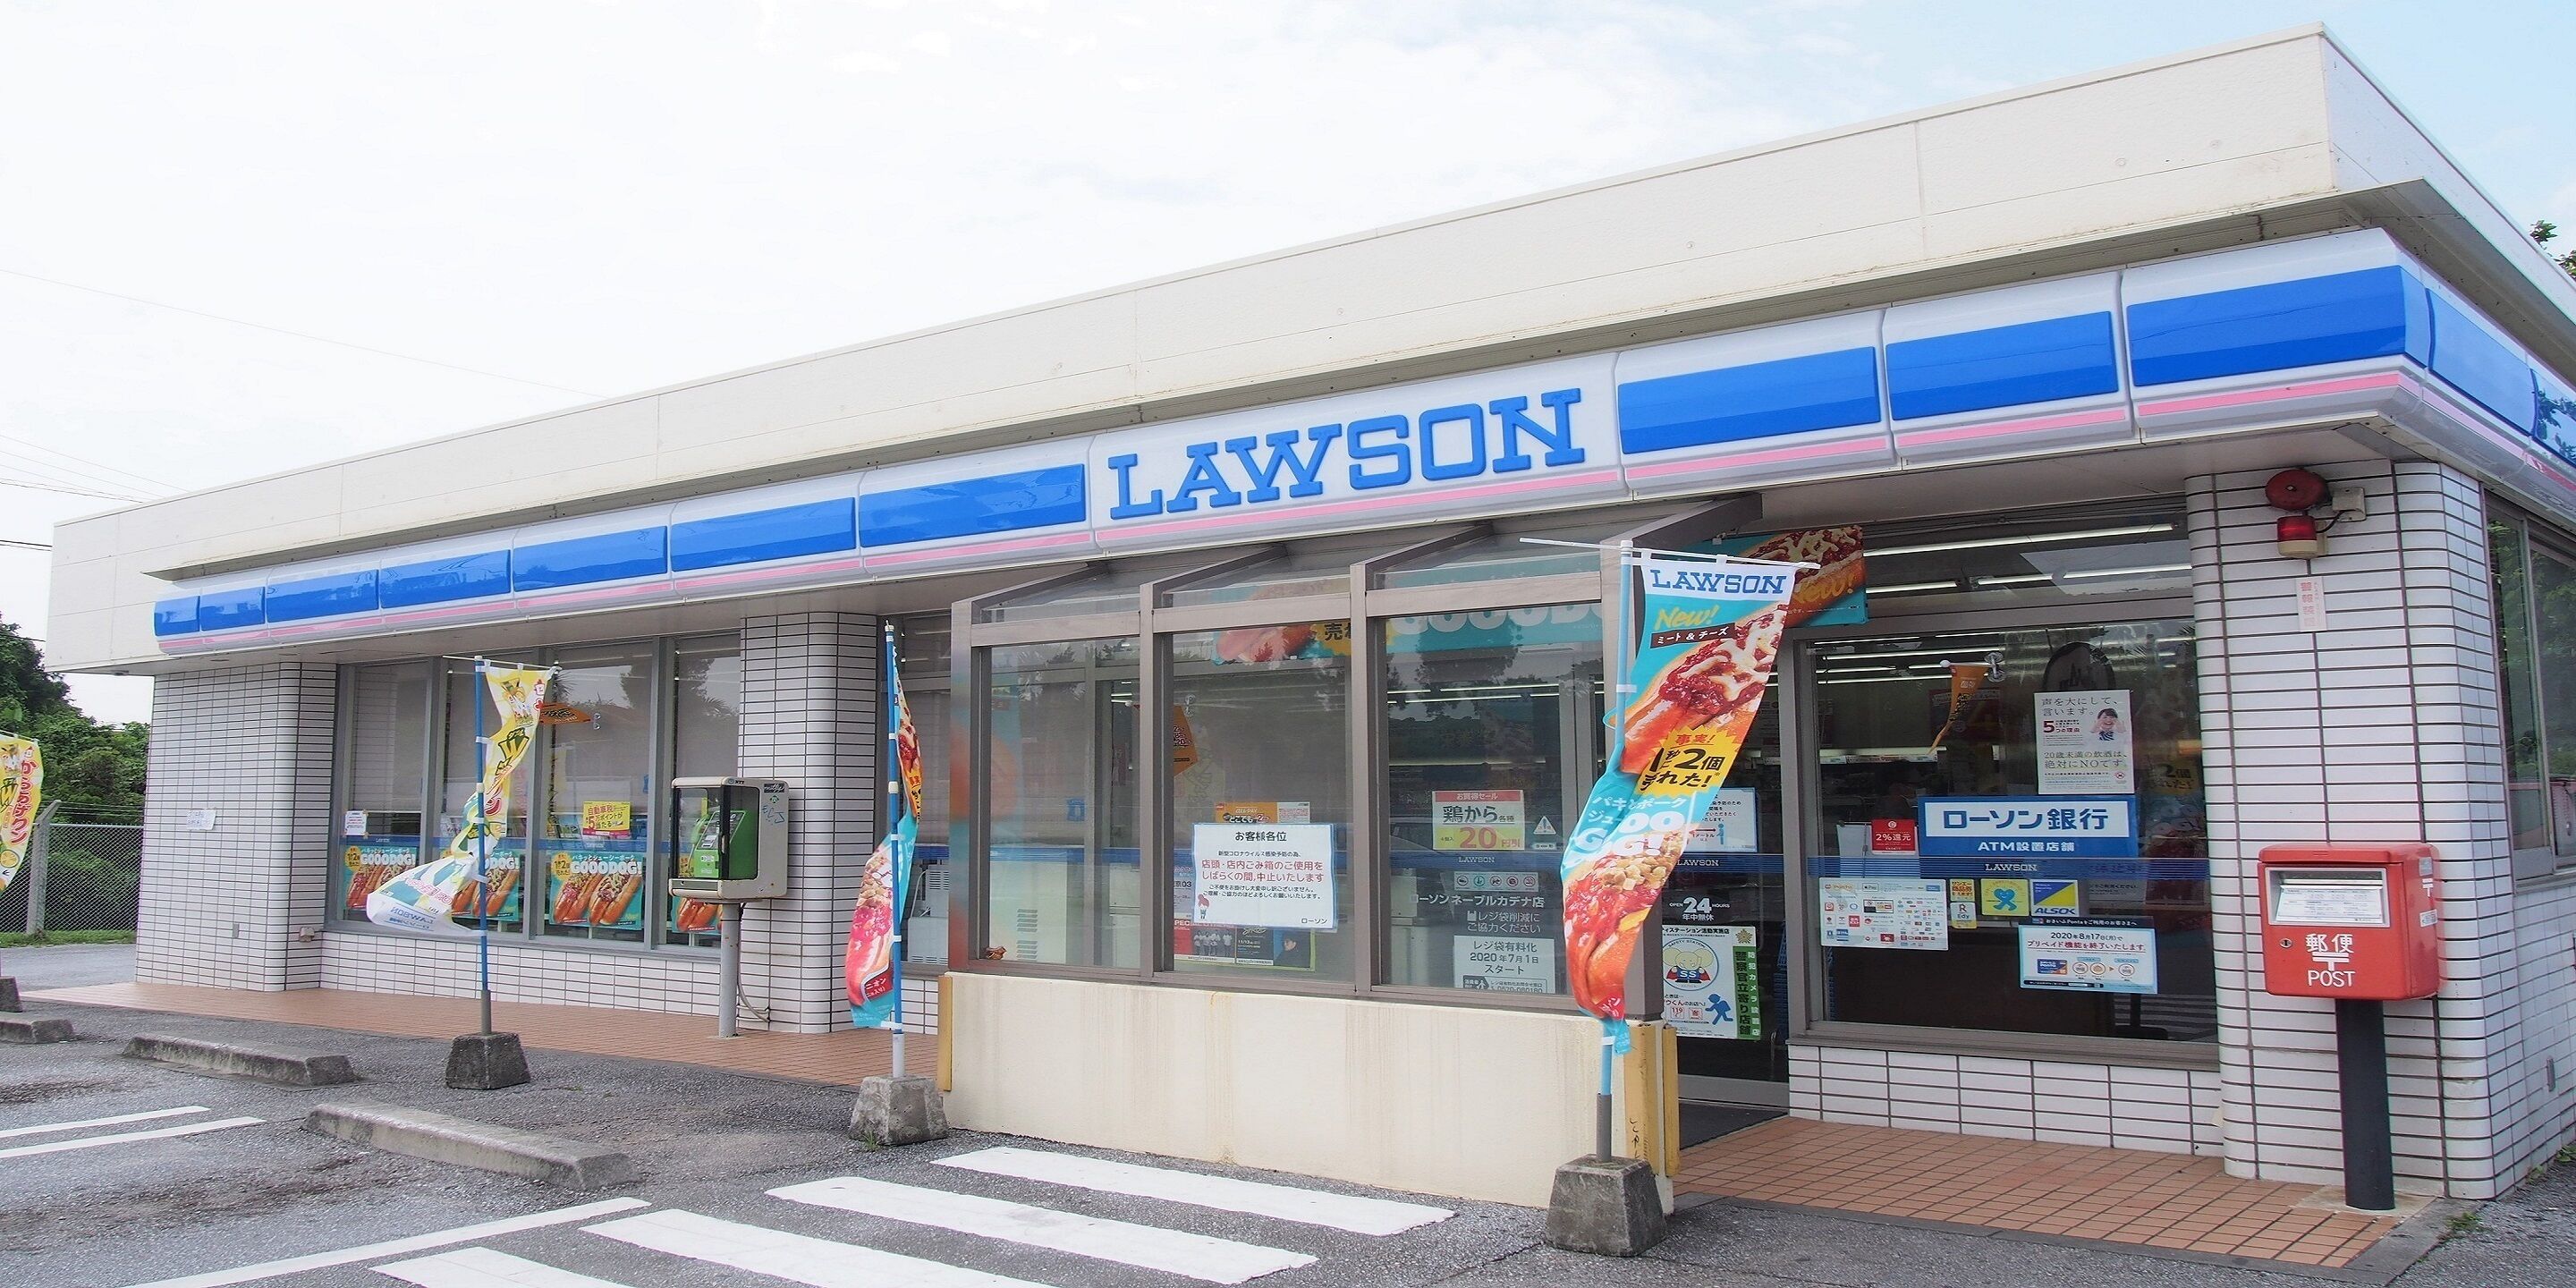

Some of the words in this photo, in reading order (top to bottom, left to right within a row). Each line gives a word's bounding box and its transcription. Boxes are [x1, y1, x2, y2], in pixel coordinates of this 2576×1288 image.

[1108, 387, 1585, 520] LAWSON
[1650, 569, 1787, 594] LAWSON
[1655, 604, 1720, 630] New!
[1657, 631, 1682, 644] ミート
[1686, 632, 1696, 640] &
[1699, 626, 1729, 640] チーズ
[2042, 697, 2118, 706] 声を大にして、
[2043, 708, 2094, 716] 言います。
[2044, 720, 2055, 733] 5
[1944, 808, 2108, 830] ローソン銀行
[1234, 831, 1287, 842] お客様各位
[1978, 842, 2075, 852] ATM設置店舗
[570, 861, 642, 875] GOOODOG!
[1201, 859, 1323, 870] 店頭・店内ごみ箱のご使用を
[1985, 863, 2038, 871] LAWSON
[1682, 897, 1712, 913] 24
[1478, 911, 1540, 922] レジ袋削減に
[1682, 913, 1715, 921] 年中無休
[1467, 922, 1541, 933] ご協力ください
[1474, 941, 1538, 953] レジ袋有料化
[2305, 933, 2354, 953] 郵便
[1470, 953, 1538, 963] 2020年7月1日
[1485, 964, 1525, 975] スタート
[2308, 970, 2356, 987] POST
